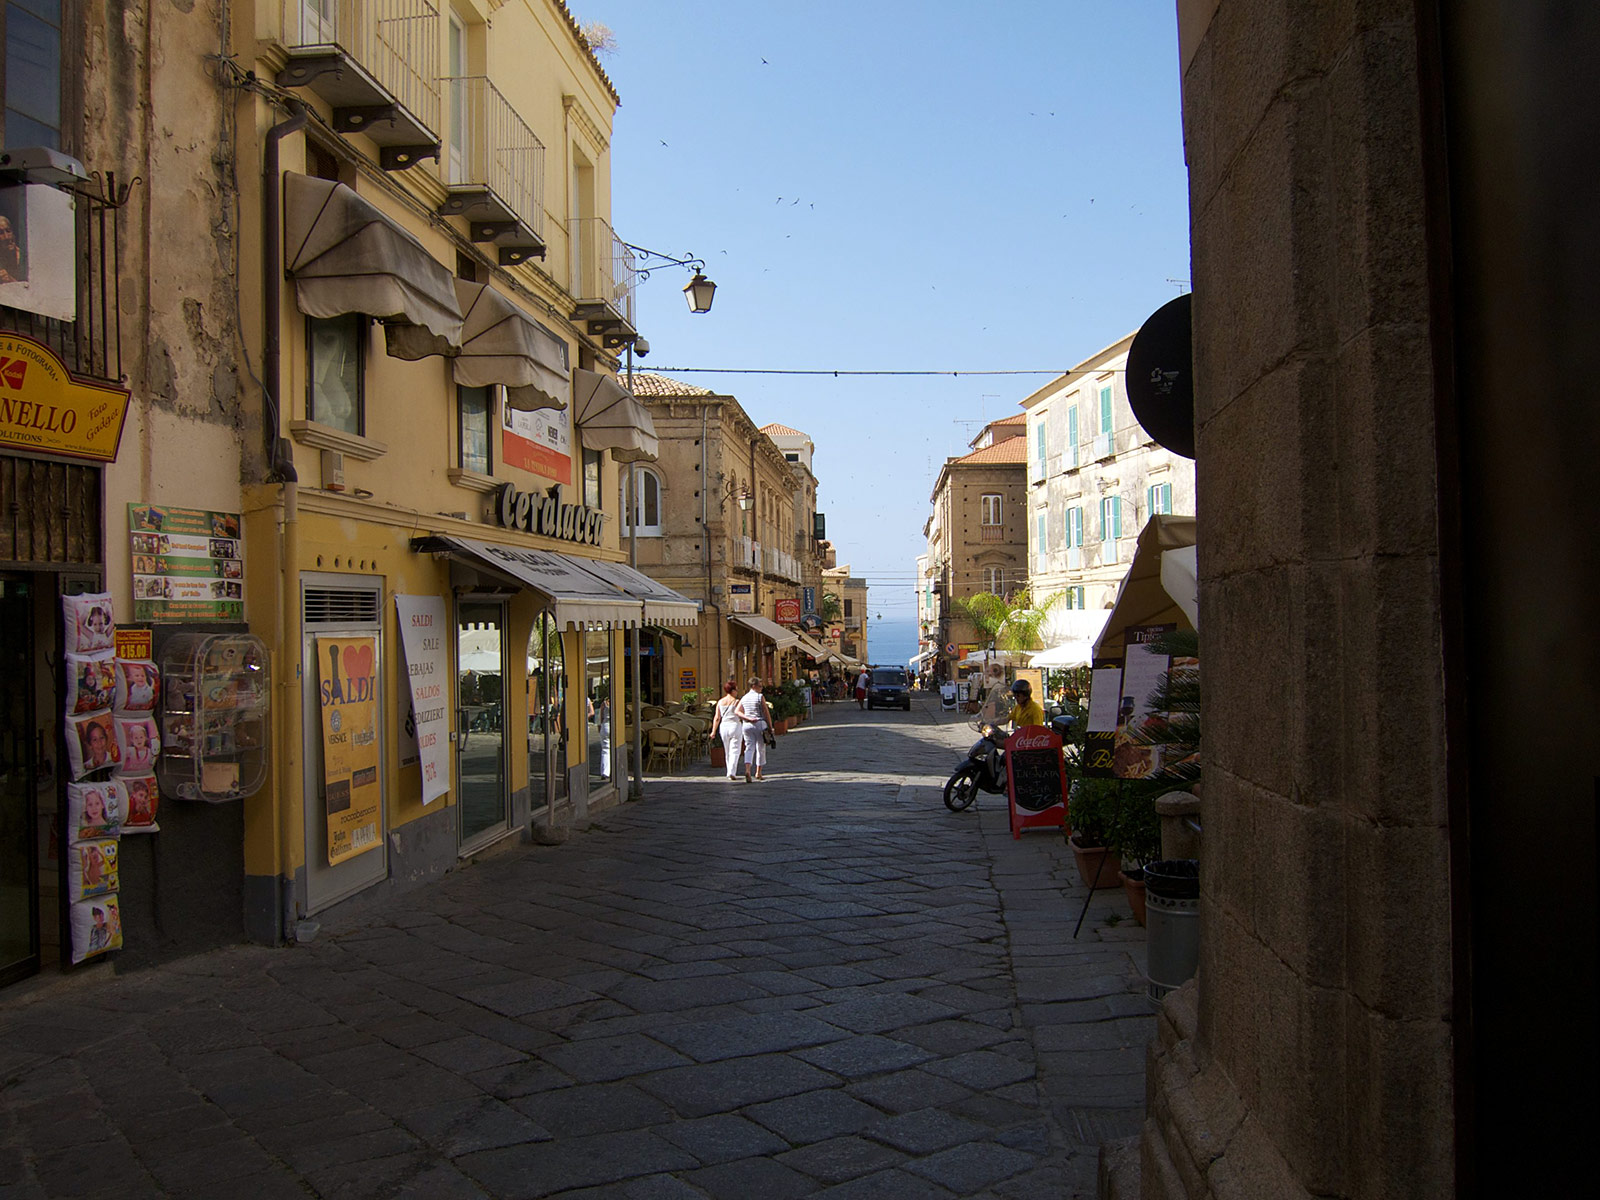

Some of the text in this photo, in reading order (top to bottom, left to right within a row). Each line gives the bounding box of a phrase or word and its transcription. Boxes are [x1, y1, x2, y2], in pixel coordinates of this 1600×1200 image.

[16, 344, 56, 379] FOTOGRAFIA
[0, 397, 77, 434] NELLO
[412, 614, 433, 627] SALDI
[422, 638, 440, 651] SALE
[321, 676, 376, 707] SALDI
[415, 684, 441, 700] SALDOS
